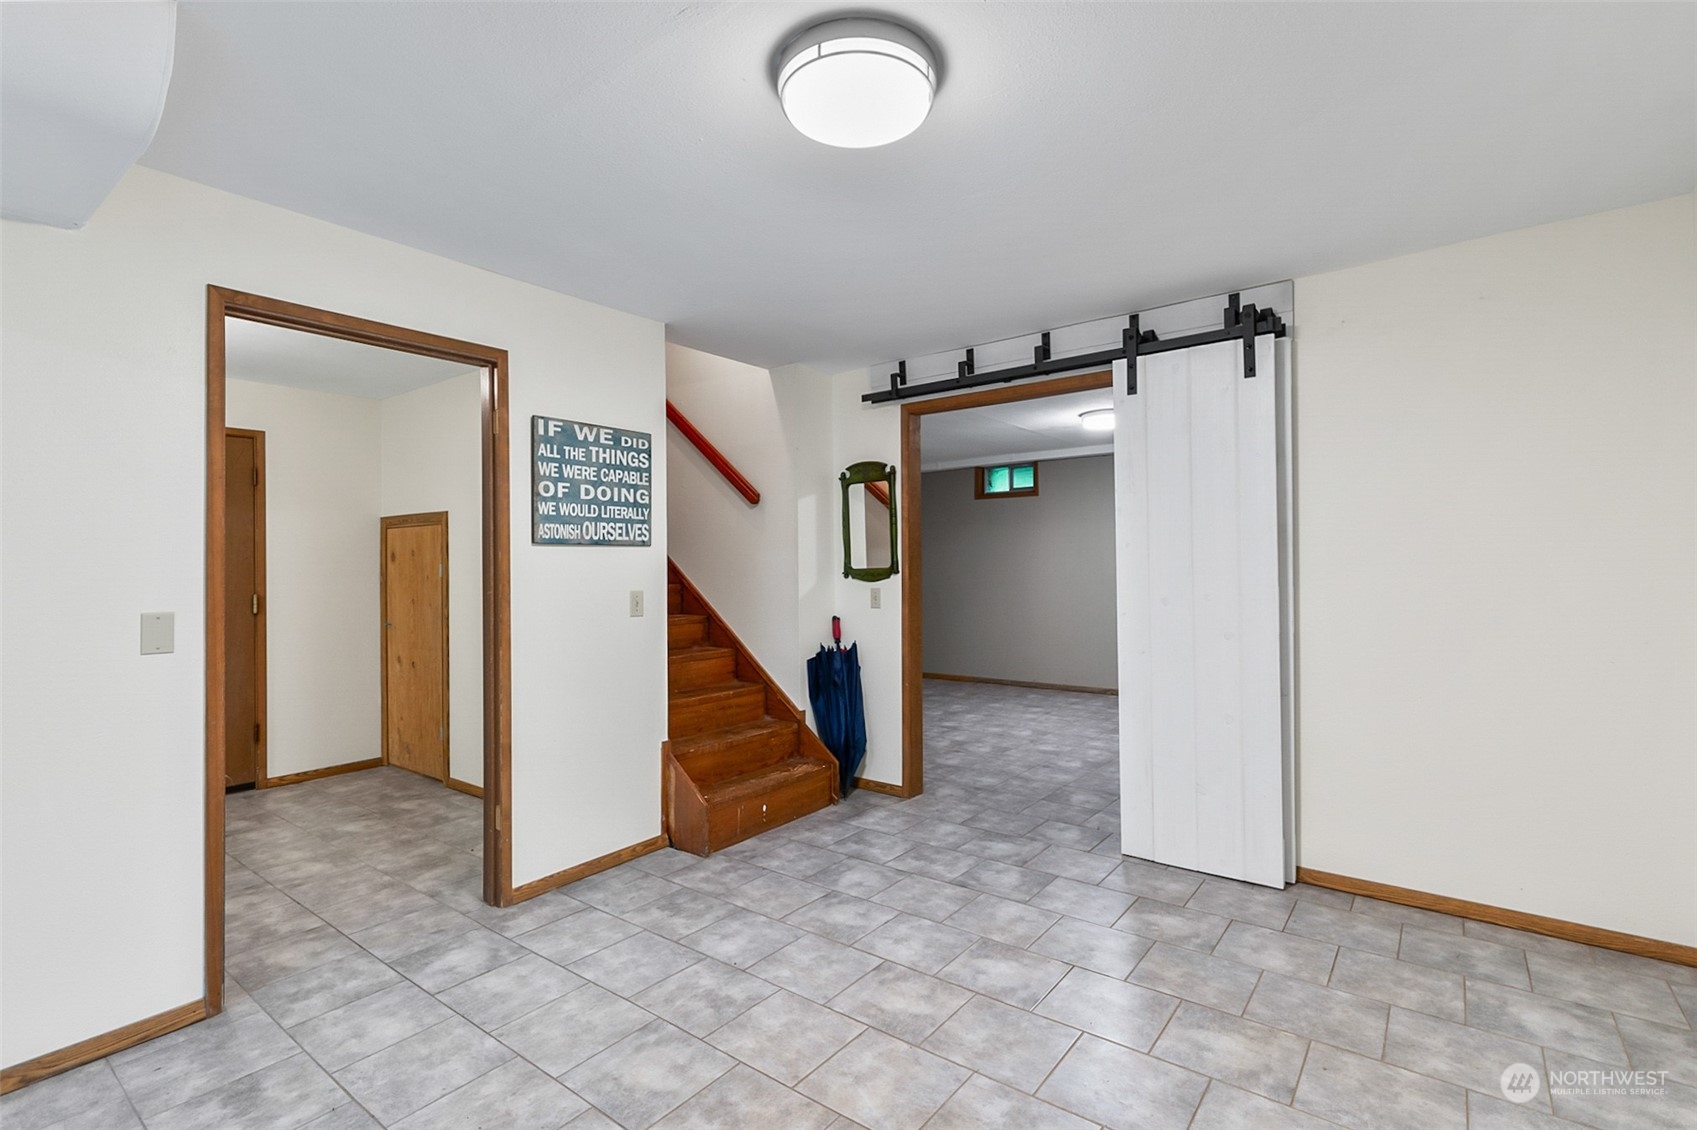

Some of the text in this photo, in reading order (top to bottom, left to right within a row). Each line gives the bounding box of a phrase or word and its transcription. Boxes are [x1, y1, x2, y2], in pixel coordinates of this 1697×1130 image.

[538, 418, 649, 449] IF WE DID
[538, 443, 649, 468] ALL THE THINGS
[538, 461, 649, 486] WE WERE CAPABLE
[538, 481, 649, 504] OF DOING
[538, 502, 649, 520] WE WOULD LITERALLY
[538, 521, 649, 542] ASTONISH OURSELVES
